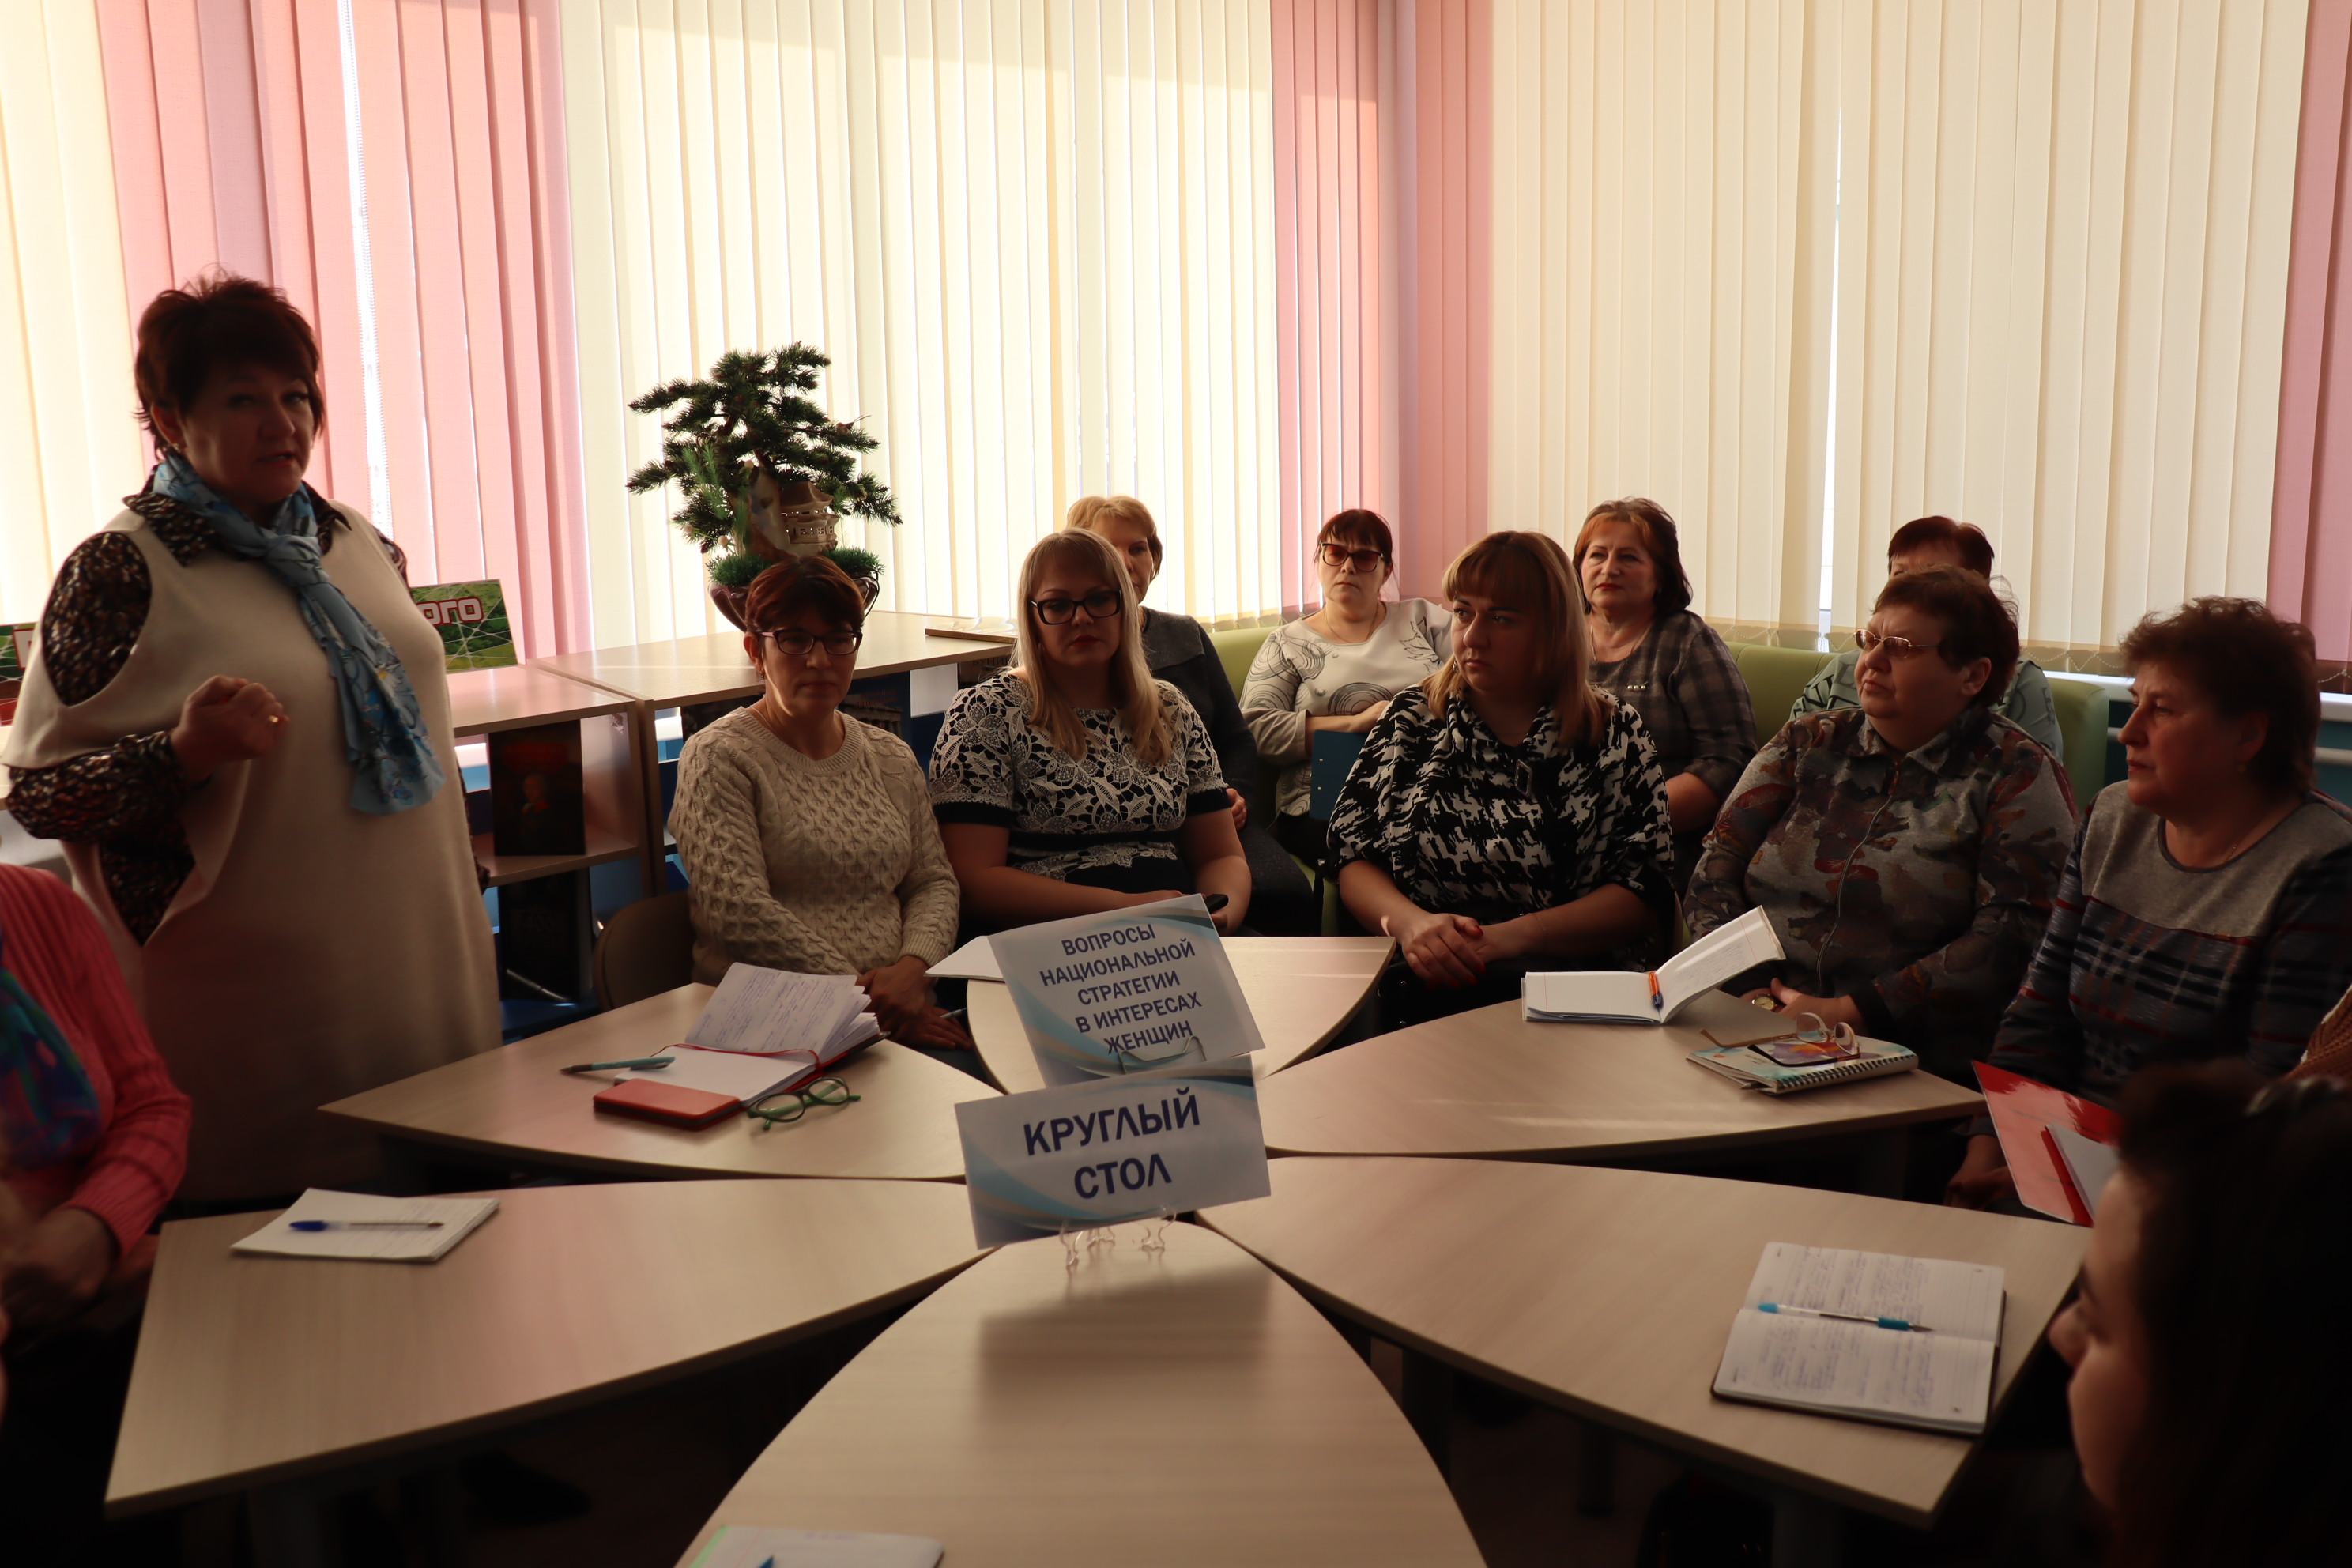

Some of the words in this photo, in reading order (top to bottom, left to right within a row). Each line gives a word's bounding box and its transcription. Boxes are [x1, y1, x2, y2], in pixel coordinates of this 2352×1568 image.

[1061, 924, 1156, 956] ВОПРОСЫ
[1039, 938, 1196, 986] НАЦИОНАЛЬНОЙ
[1077, 971, 1181, 1005] СТРАТЕГИИ
[1075, 1016, 1091, 1033] В
[1093, 992, 1203, 1029] ИНТЕРЕСАХ
[1103, 1020, 1193, 1054] ЖЕНЩИН
[1023, 1087, 1200, 1156] КРУГЛЫЙ
[1074, 1153, 1172, 1199] СТОЛ
